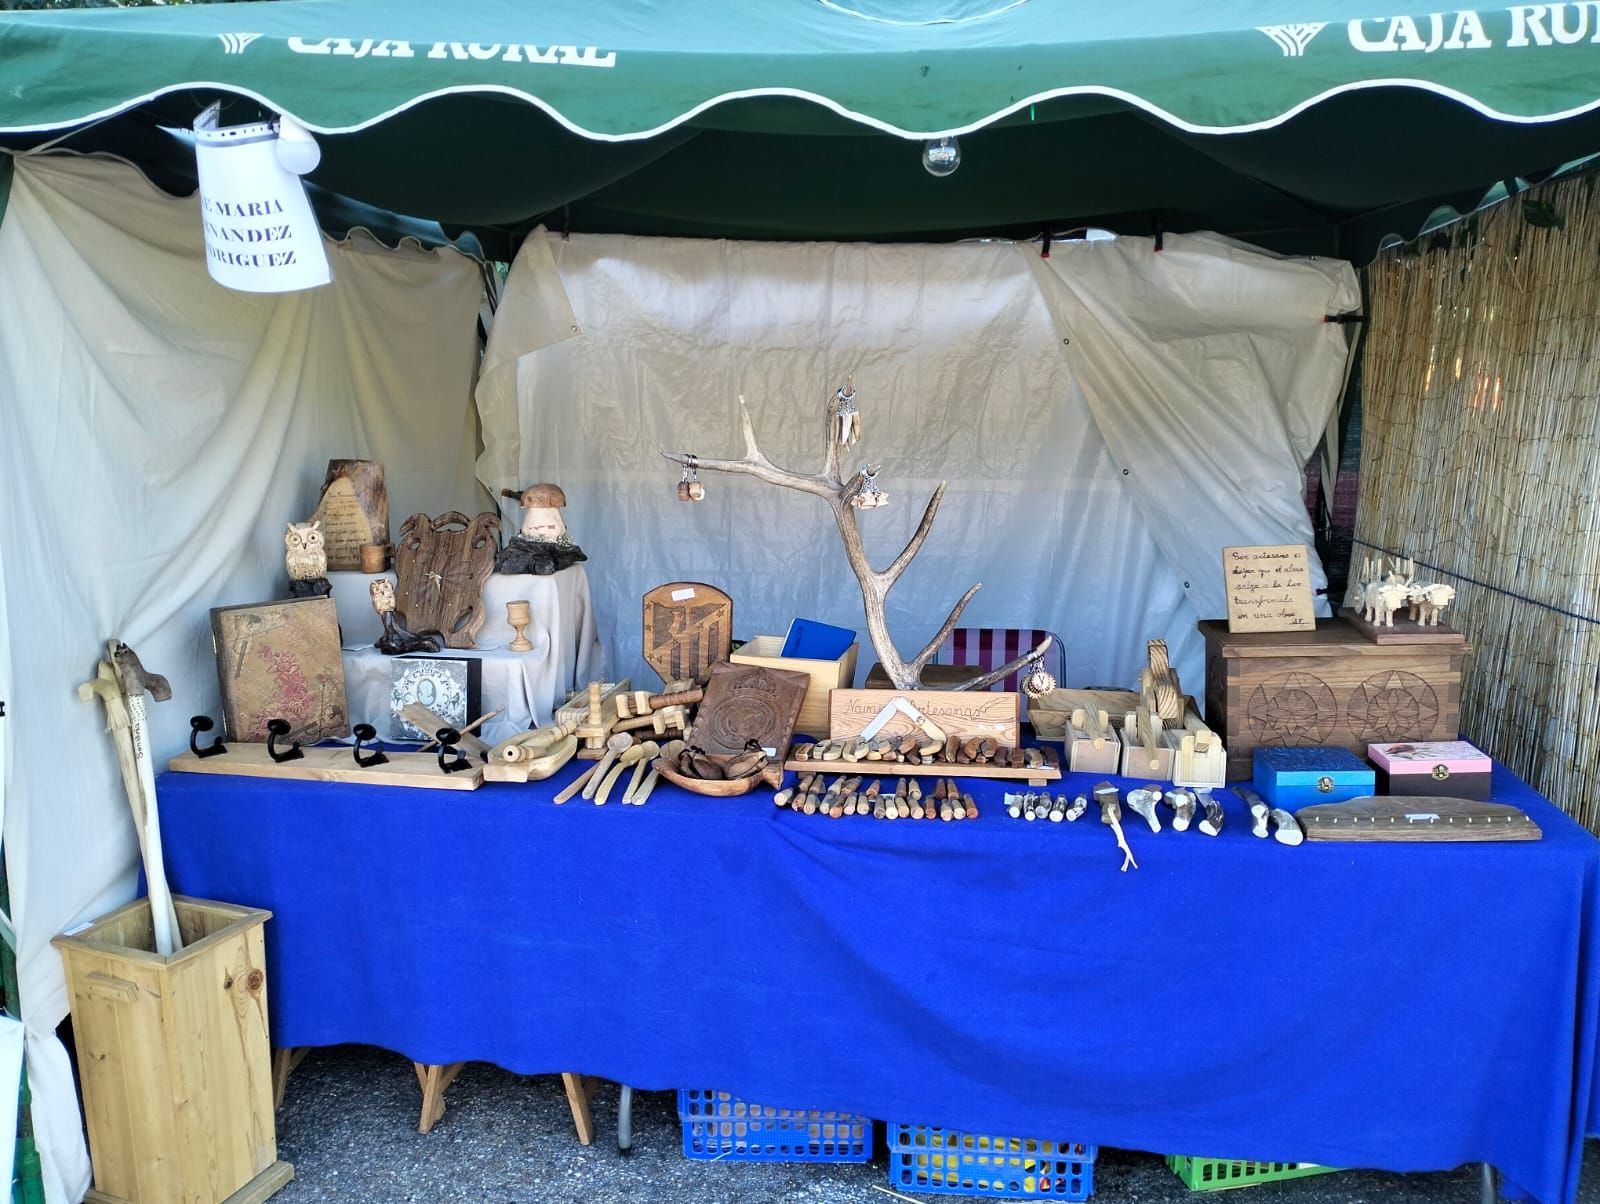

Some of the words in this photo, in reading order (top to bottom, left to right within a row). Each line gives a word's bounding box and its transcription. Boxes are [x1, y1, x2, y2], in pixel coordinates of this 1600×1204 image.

[1347, 9, 1492, 54] CAJA
[1505, 0, 1600, 48] RU
[215, 199, 284, 217] MARIA
[1232, 551, 1250, 560] Ser
